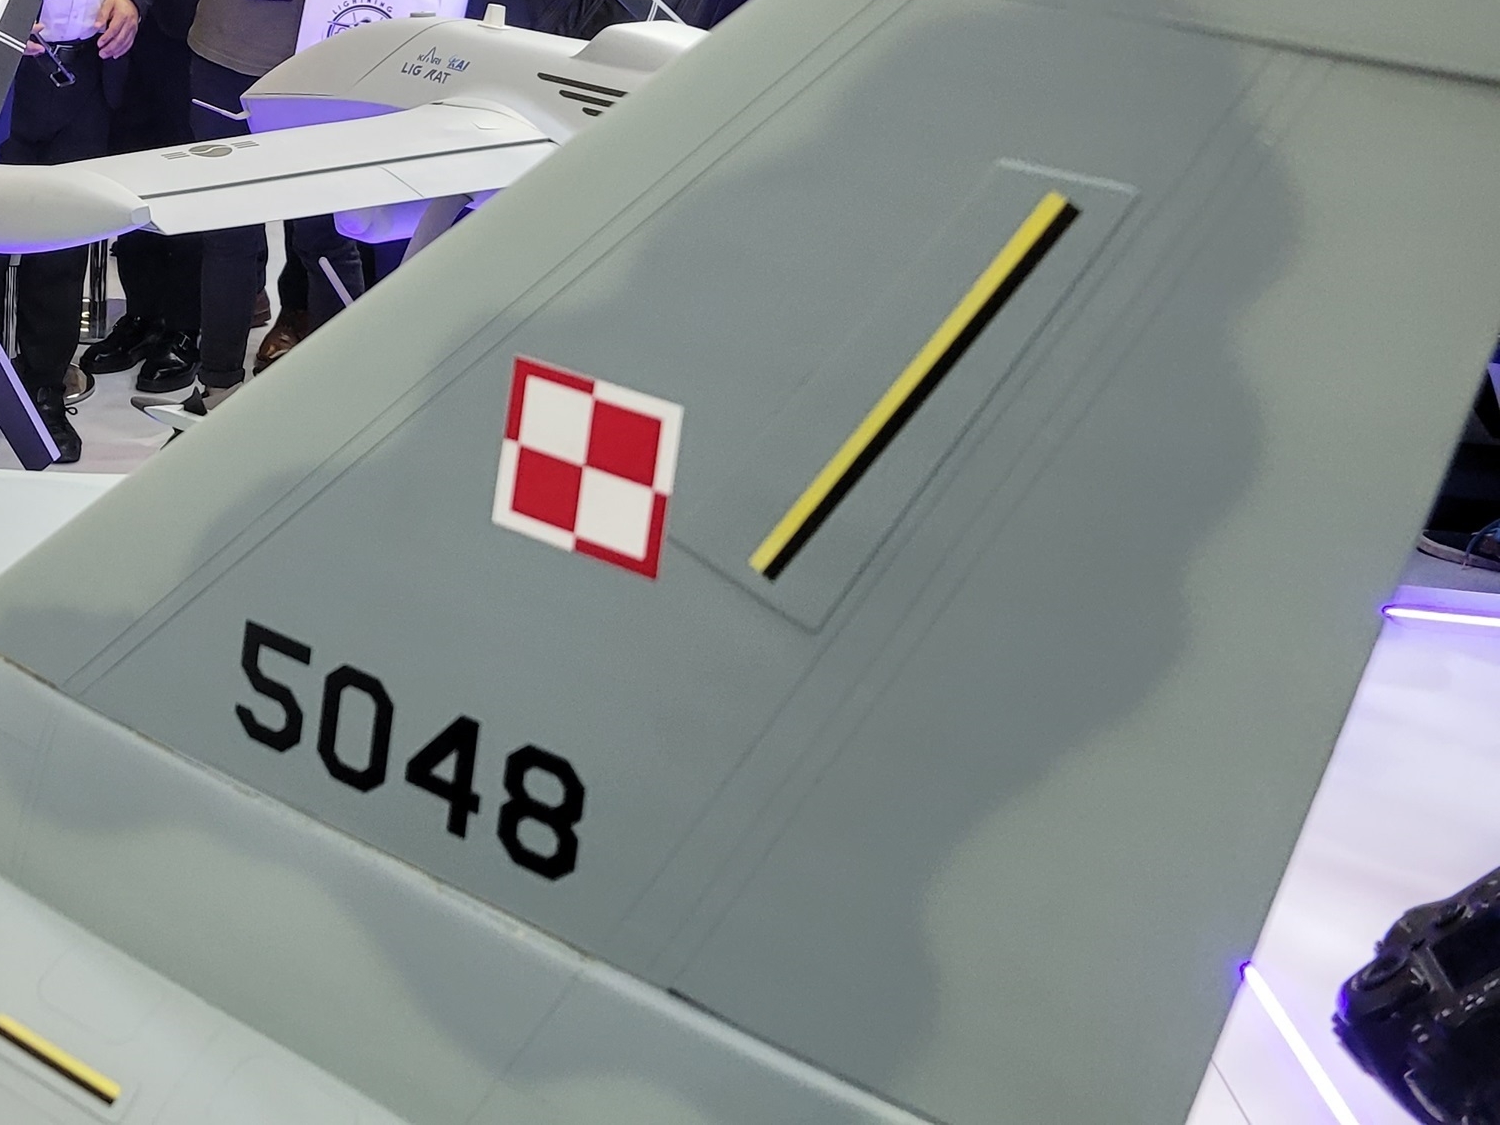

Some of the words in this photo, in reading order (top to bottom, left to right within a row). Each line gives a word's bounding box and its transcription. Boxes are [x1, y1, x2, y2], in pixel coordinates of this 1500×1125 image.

[401, 61, 423, 76] LIG
[446, 54, 471, 72] KAI
[235, 619, 586, 882] 5048
